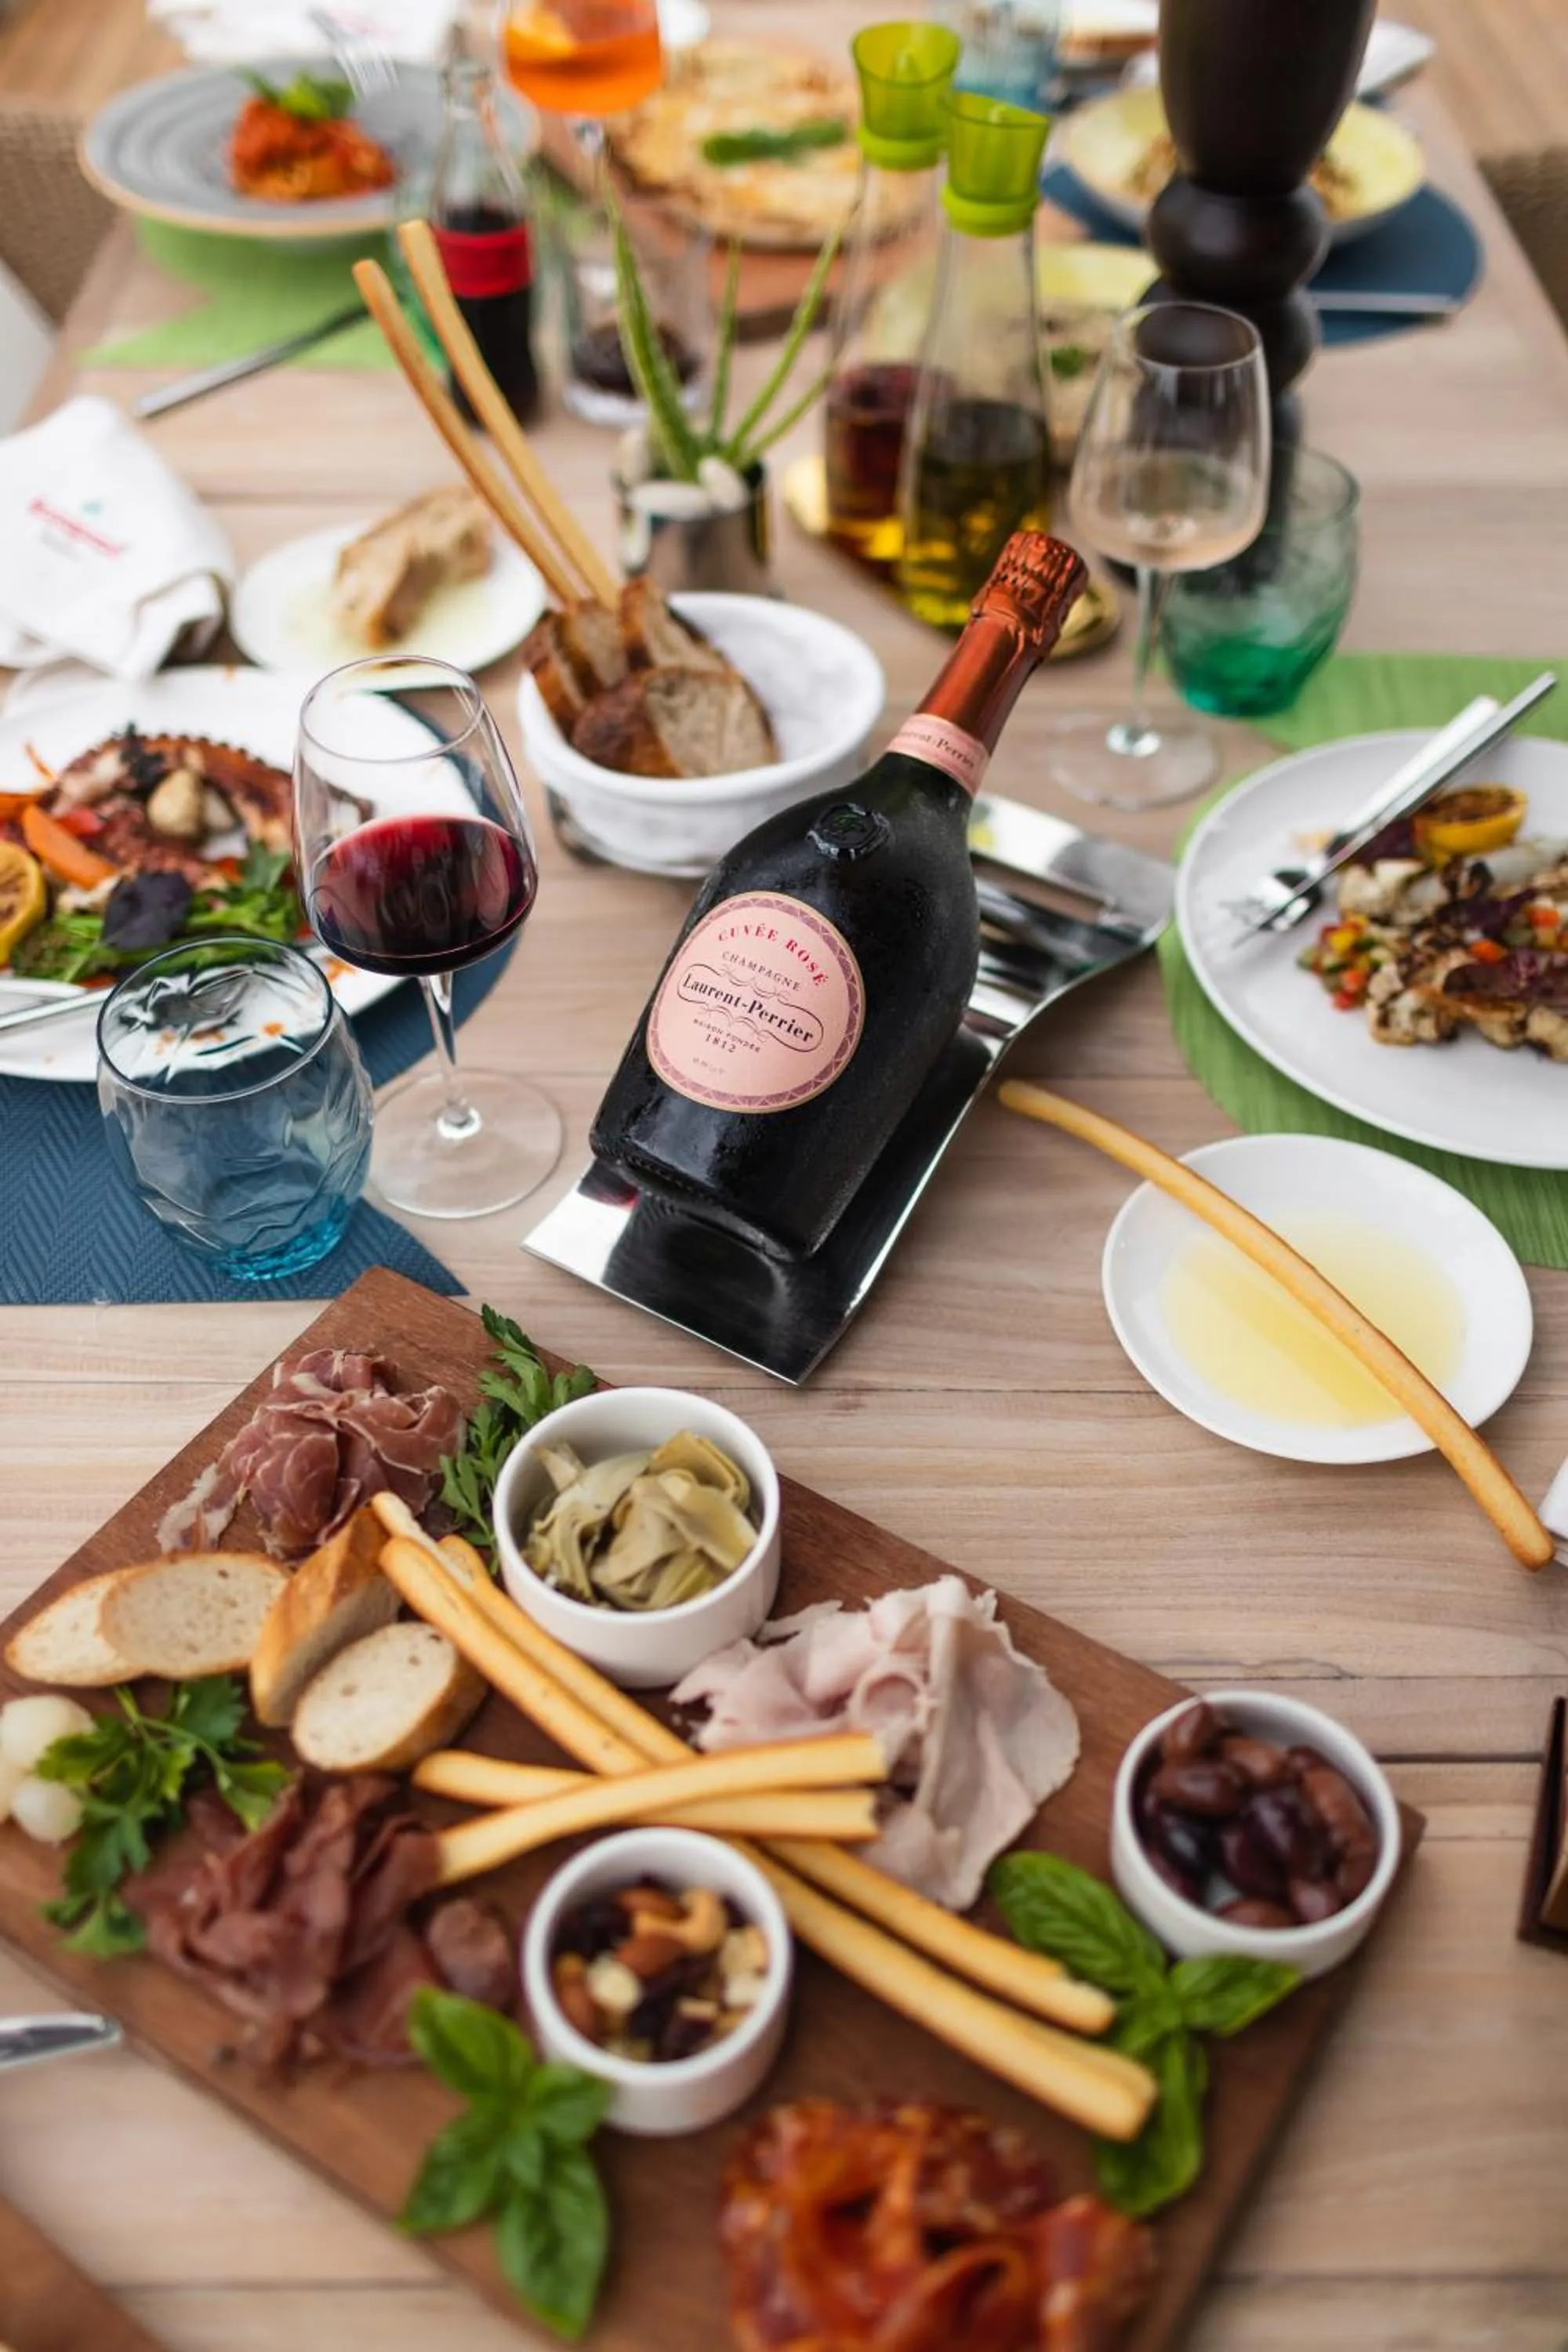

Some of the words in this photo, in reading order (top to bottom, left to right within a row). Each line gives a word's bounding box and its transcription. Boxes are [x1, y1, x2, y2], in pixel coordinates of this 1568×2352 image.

[718, 923, 779, 942] CUVÉE
[786, 939, 829, 986] ROSÉ
[721, 951, 800, 991] CHAMPAGNE
[682, 974, 813, 1042] Laurent-Perrier
[706, 1034, 736, 1053] 1812
